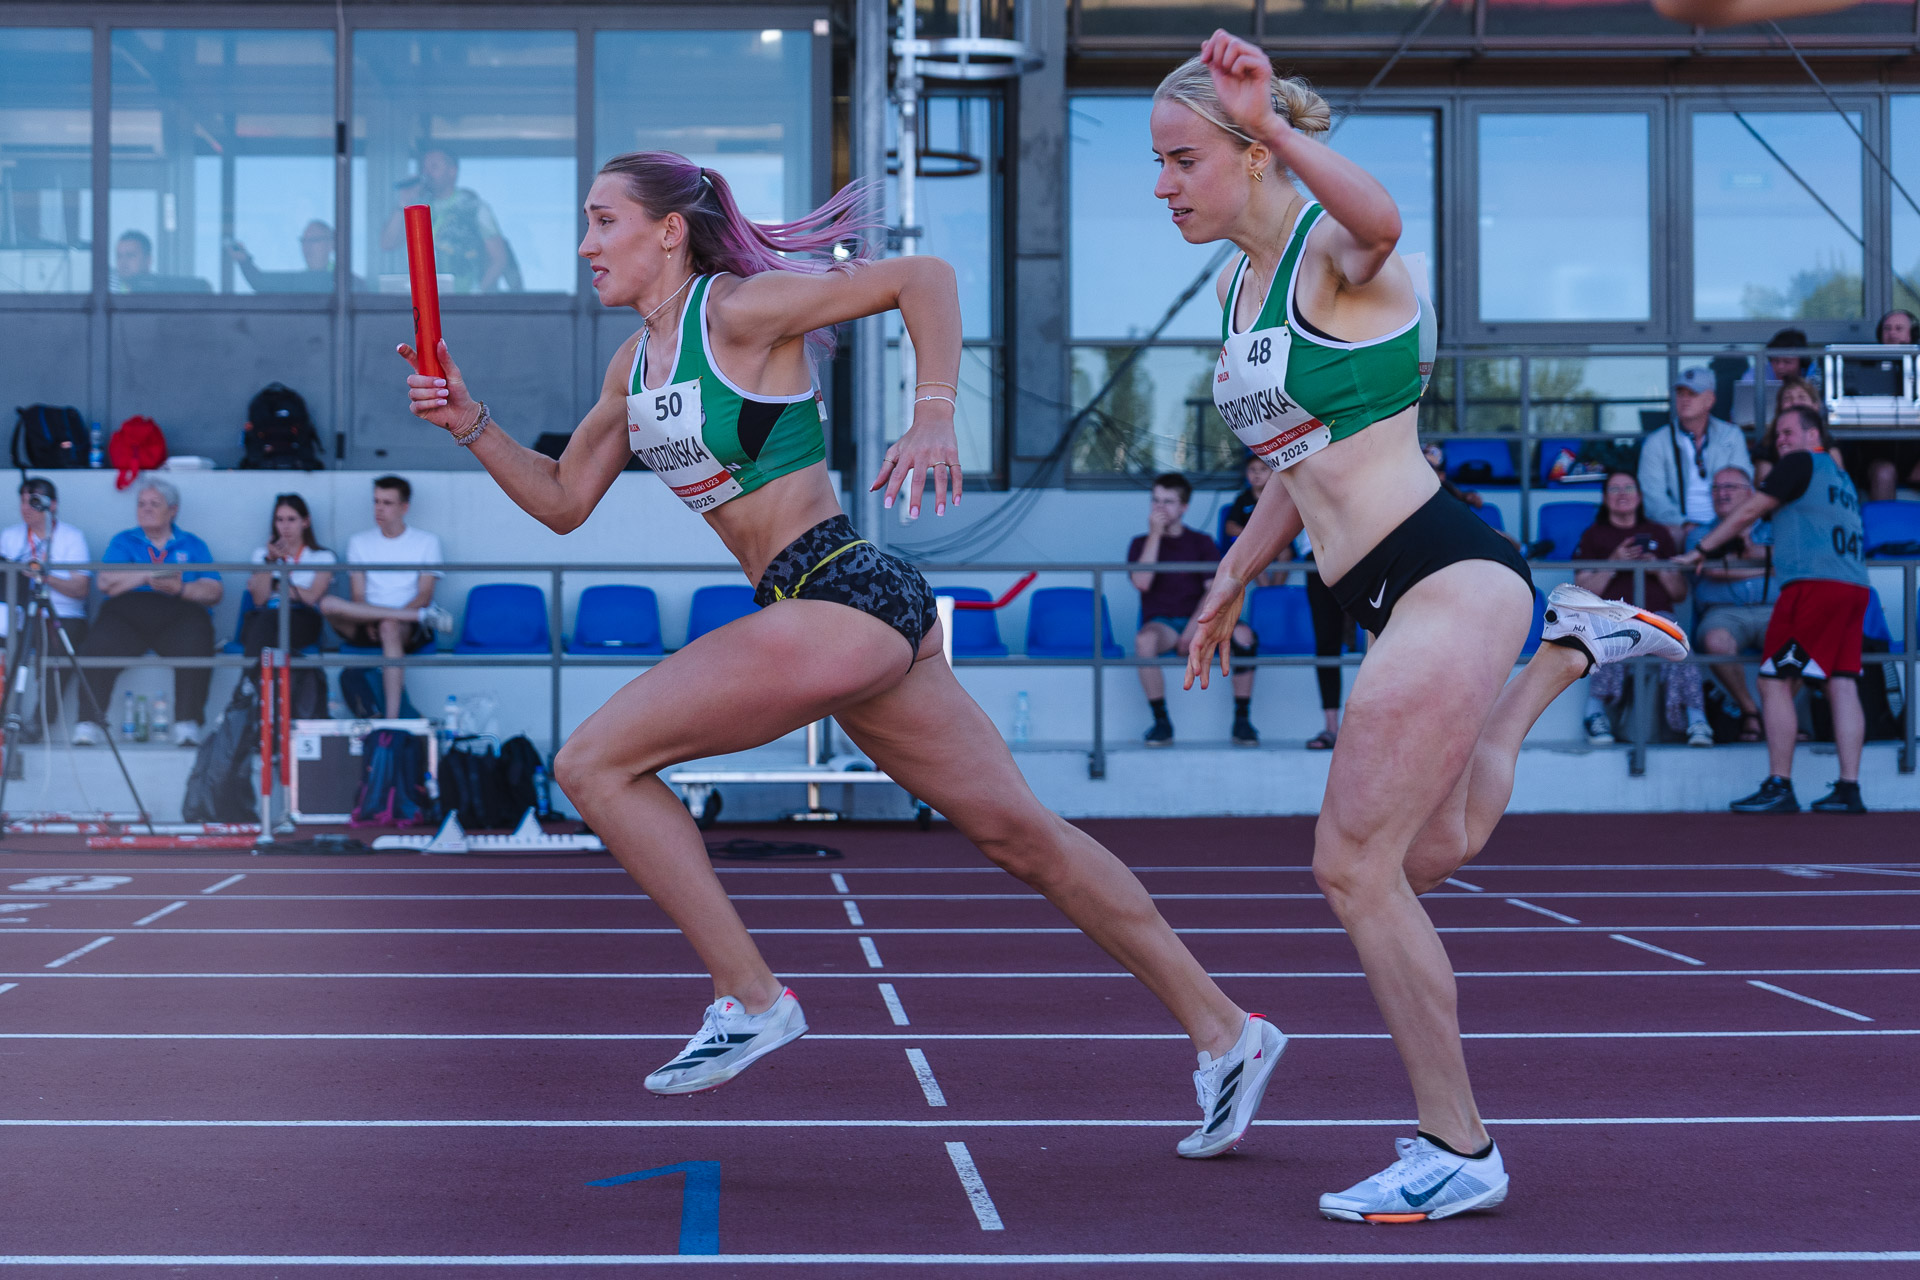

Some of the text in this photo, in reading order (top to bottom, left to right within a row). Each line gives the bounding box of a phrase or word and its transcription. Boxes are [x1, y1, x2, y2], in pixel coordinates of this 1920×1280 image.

[1247, 337, 1272, 367] 48
[655, 391, 683, 421] 50
[1218, 386, 1298, 431] BORKOWSKA
[1276, 430, 1299, 445] Polski
[1297, 423, 1312, 434] U23
[1281, 440, 1309, 463] 2025
[704, 477, 720, 488] U23
[692, 494, 716, 509] 2025
[583, 1160, 720, 1256] 1
